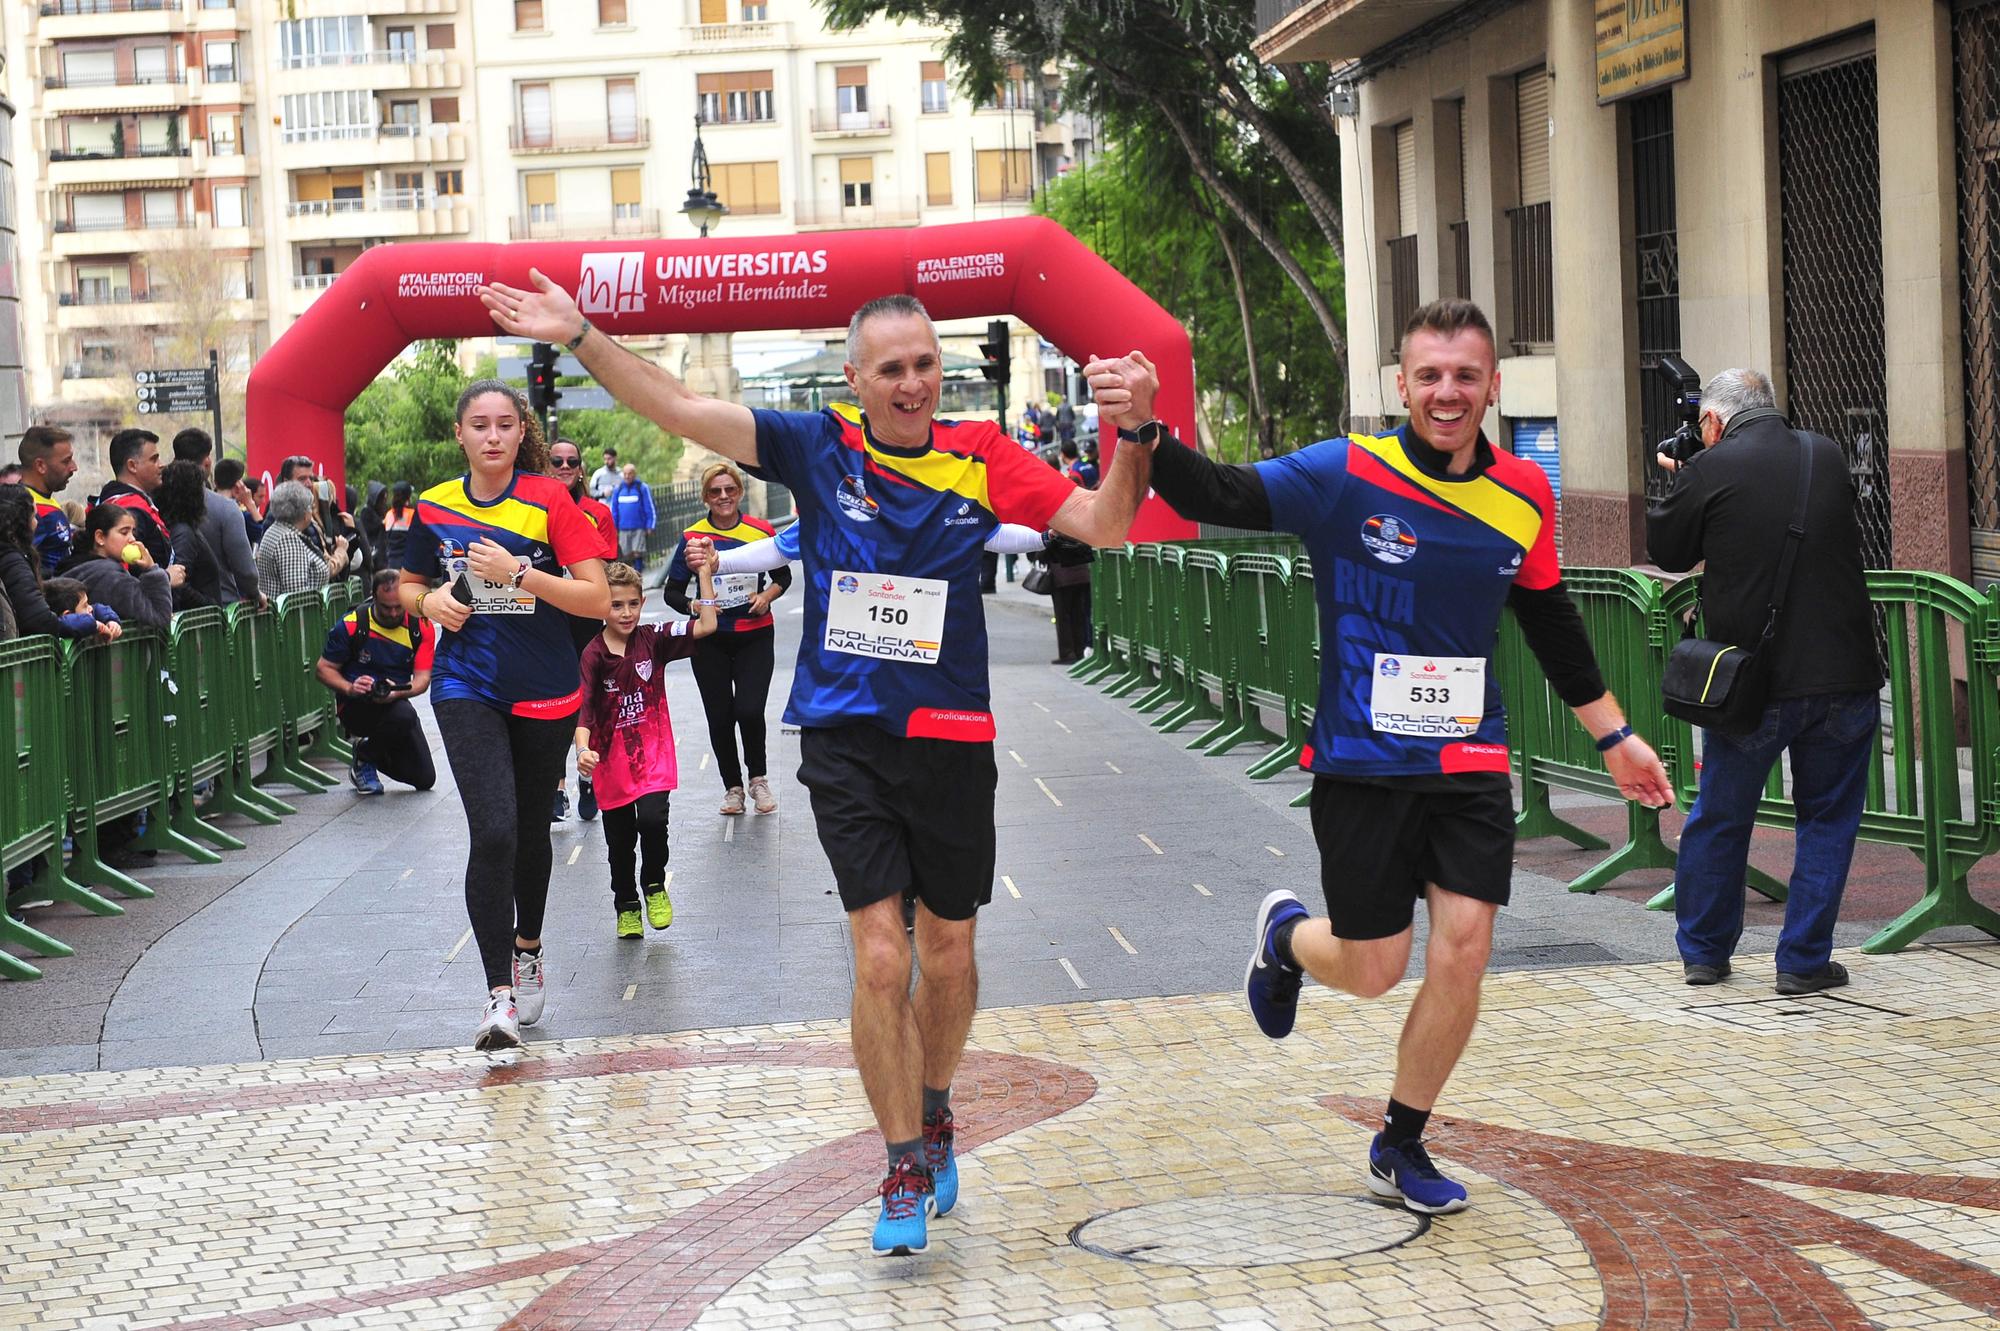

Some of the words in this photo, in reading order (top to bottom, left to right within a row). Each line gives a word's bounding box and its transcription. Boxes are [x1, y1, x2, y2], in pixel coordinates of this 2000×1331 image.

[655, 250, 827, 280] UNIVERSITAS
[917, 253, 1004, 272] #TALENTOEN
[399, 272, 483, 285] #TALENTOEN
[917, 264, 1005, 284] MOVIMIENTO
[657, 284, 720, 310] Miguel
[727, 279, 827, 302] Hernández
[868, 589, 906, 601] Santander
[1334, 556, 1415, 625] RUTA
[868, 605, 909, 625] 150
[829, 628, 916, 649] POLICIA
[828, 638, 937, 660] NACIONAL
[1409, 687, 1450, 703] 533
[1374, 712, 1458, 725] POLICIA
[1376, 720, 1477, 735] NACIONAL
